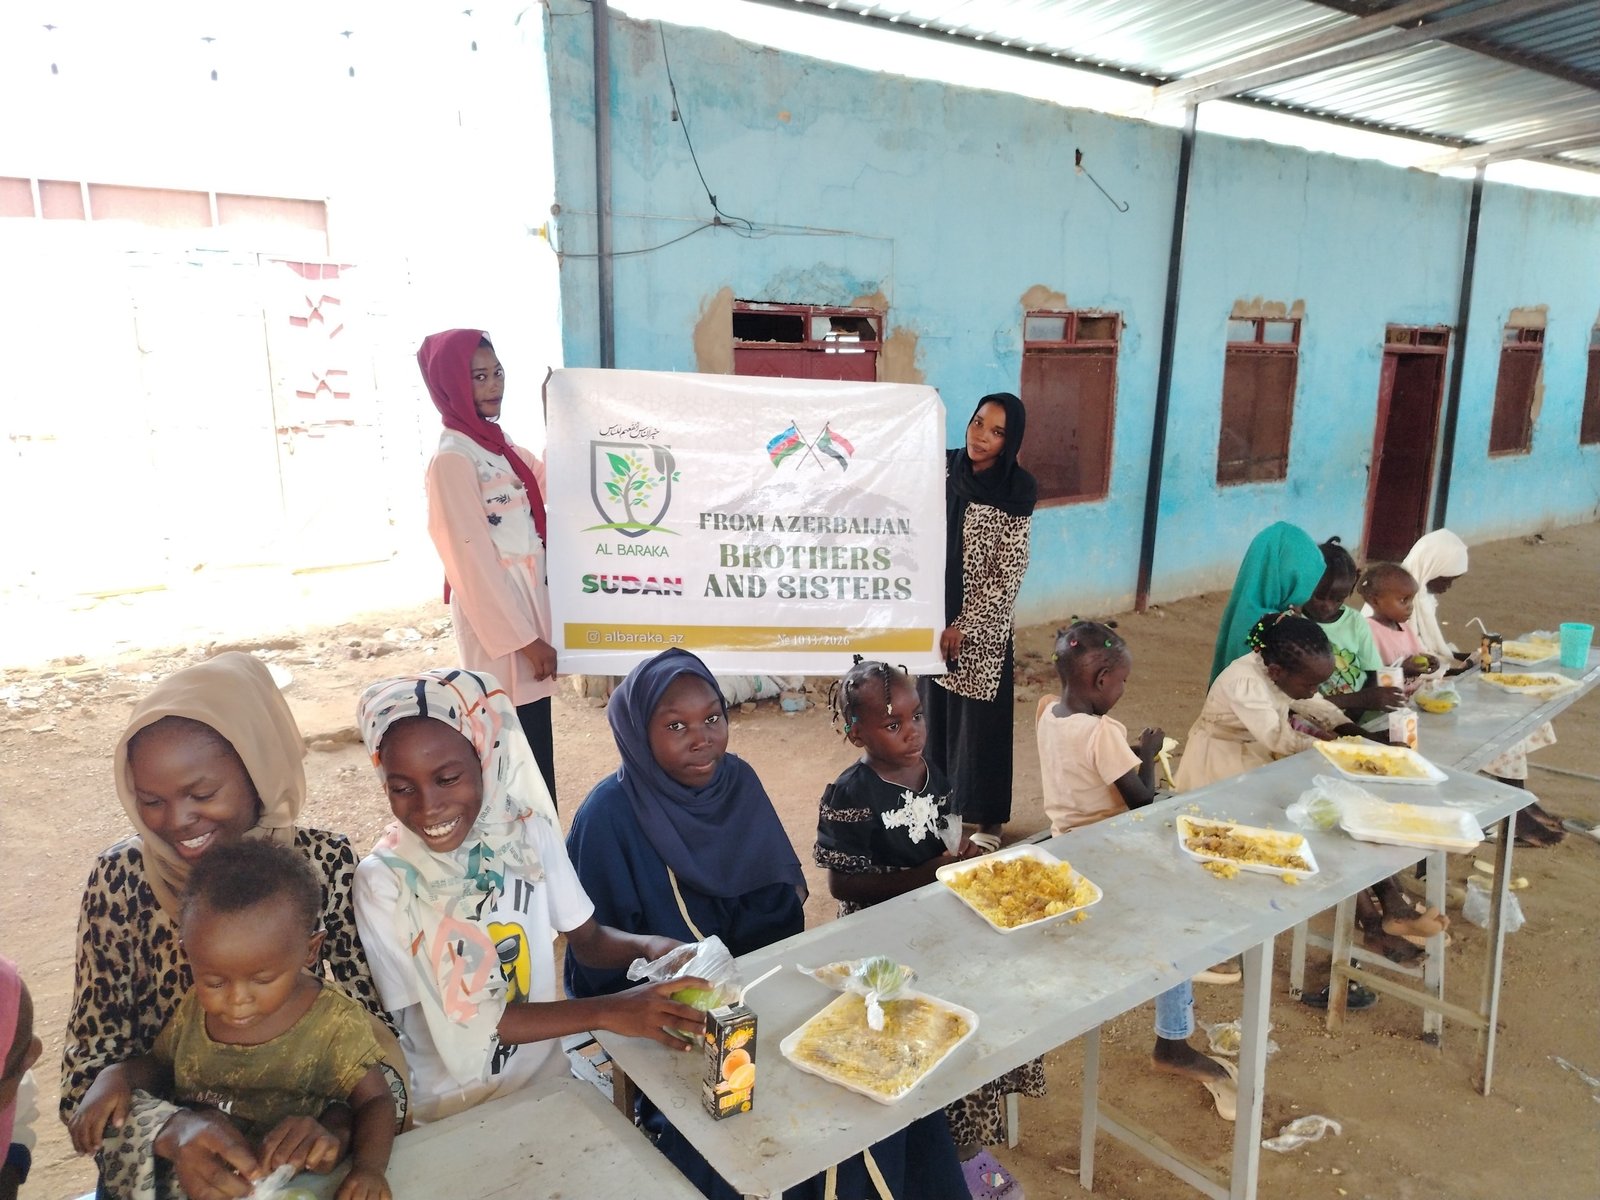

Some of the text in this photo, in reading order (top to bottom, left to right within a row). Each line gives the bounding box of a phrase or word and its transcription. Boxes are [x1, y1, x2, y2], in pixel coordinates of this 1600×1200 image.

[699, 512, 910, 535] FROM AZERBAIJAN
[595, 543, 670, 558] AL BARAKA
[719, 543, 891, 571] BROTHERS
[581, 574, 683, 596] SUDAN
[703, 573, 912, 600] AND SISTERS
[605, 631, 684, 644] albaraka_az
[513, 879, 535, 915] IT
